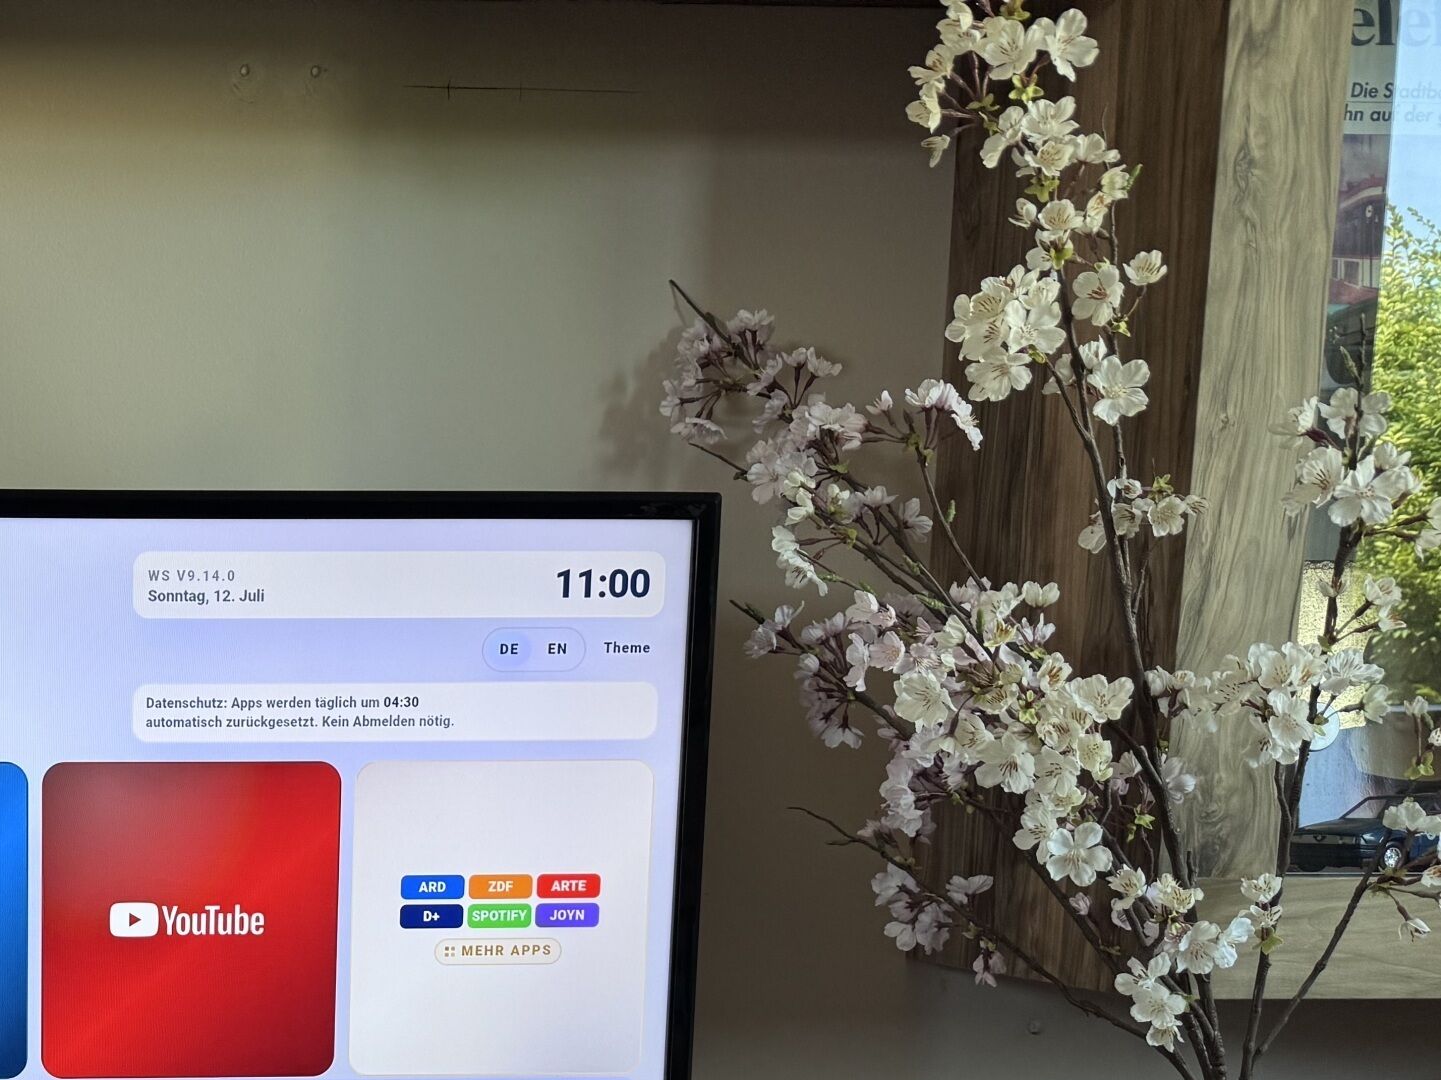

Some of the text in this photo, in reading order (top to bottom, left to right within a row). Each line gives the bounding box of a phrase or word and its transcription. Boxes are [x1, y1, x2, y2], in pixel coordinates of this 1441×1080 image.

[1351, 82, 1378, 98] Die
[148, 569, 236, 582] WS V9.14.0
[556, 568, 651, 599] 11:00
[148, 588, 264, 605] Sonntag, 12. Juli
[499, 641, 651, 656] DE EN Theme
[145, 695, 419, 712] Datenschutz: Apps werden täglich um 04:30
[145, 714, 455, 731] automatisch zurückgesetzt. Kein Abmelden nötig.
[418, 881, 446, 893] ARD
[488, 880, 513, 892] ZDF
[551, 880, 587, 892] ARTE
[162, 905, 265, 936] YouTube
[423, 910, 440, 922] D+
[472, 909, 527, 922] SPOTIFY
[549, 909, 585, 921] JOYN
[461, 944, 551, 956] MEHR APPS
